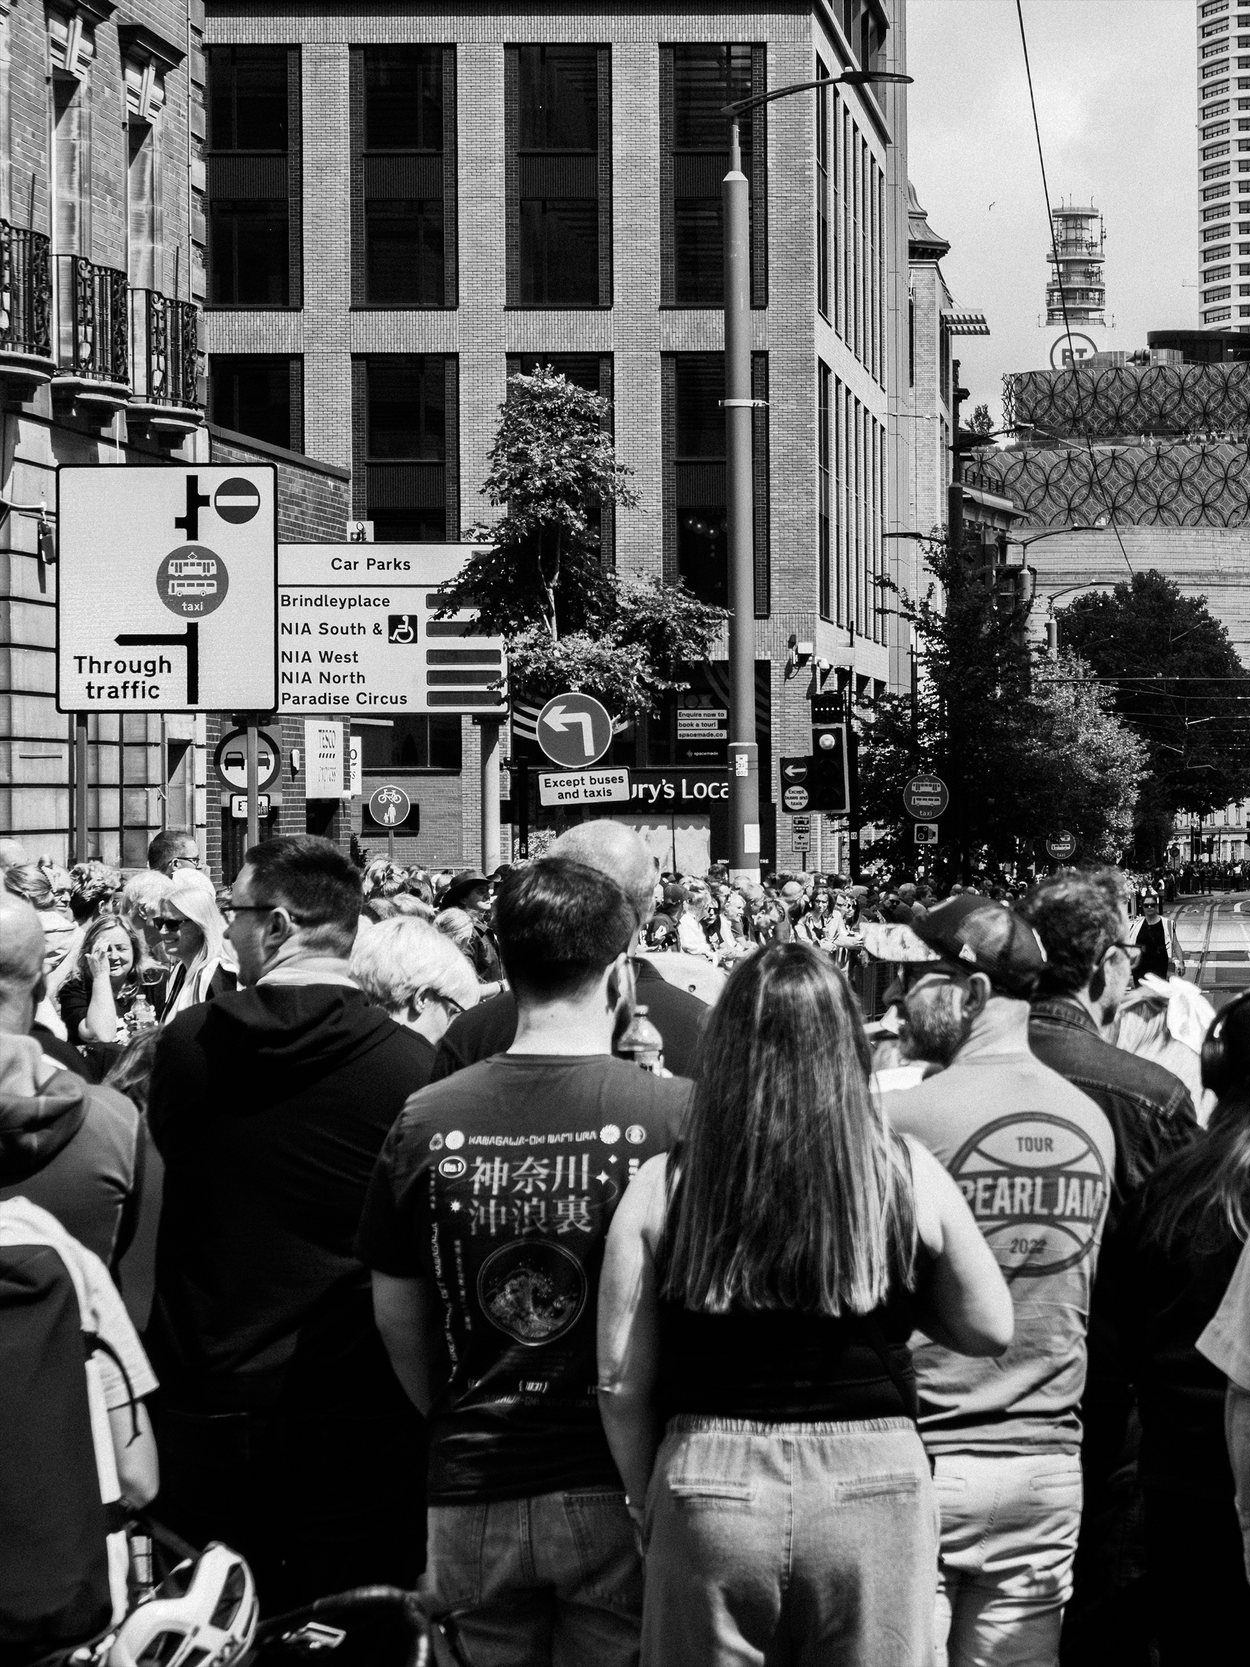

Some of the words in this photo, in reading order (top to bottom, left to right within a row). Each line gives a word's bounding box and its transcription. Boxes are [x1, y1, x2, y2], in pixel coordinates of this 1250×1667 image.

[331, 557, 359, 570] Car
[366, 557, 411, 571] Parks
[181, 601, 203, 612] taxi
[281, 594, 391, 609] Brindleyplace
[281, 622, 311, 635] NIA
[318, 622, 366, 635] South
[372, 622, 383, 635] &
[281, 650, 312, 663] NIA
[319, 650, 359, 663] West
[73, 655, 172, 677] Through
[282, 672, 312, 684] NIA
[319, 671, 366, 684] North
[86, 680, 160, 700] traffic
[281, 692, 350, 705] Paradise
[356, 692, 408, 705] Circus
[318, 729, 337, 748] TESCO
[544, 776, 585, 789] Except
[589, 774, 625, 786] buses
[557, 788, 580, 800] and
[583, 785, 613, 798] taxis
[575, 1130, 597, 1142] URA
[1016, 1136, 1054, 1152] TOUR
[469, 1153, 591, 1196] 神奈川
[957, 1176, 1049, 1216] PEARL
[1053, 1176, 1104, 1218] JAM
